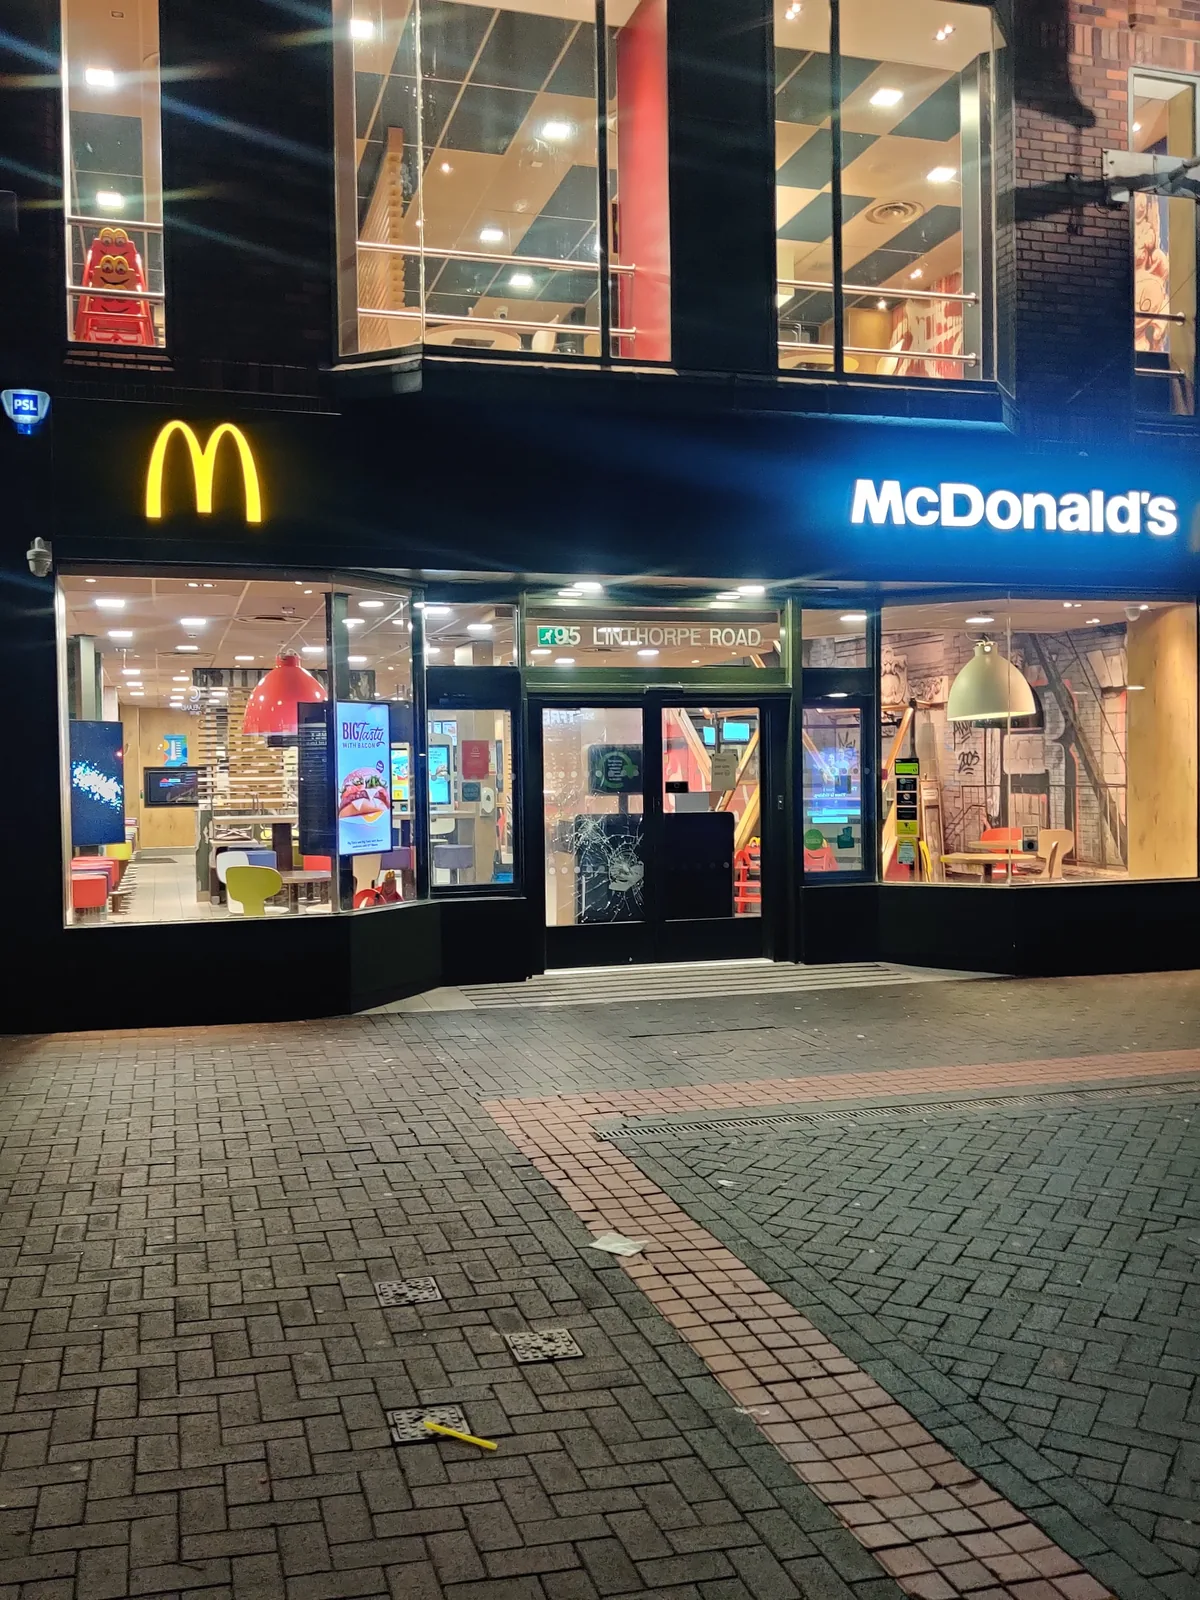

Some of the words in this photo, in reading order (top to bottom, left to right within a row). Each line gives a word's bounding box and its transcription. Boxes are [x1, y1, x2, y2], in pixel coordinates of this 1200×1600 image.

[14, 398, 37, 411] PSL
[851, 478, 1178, 536] McDonald's
[592, 626, 702, 647] LINTHORPE
[709, 627, 762, 647] ROAD
